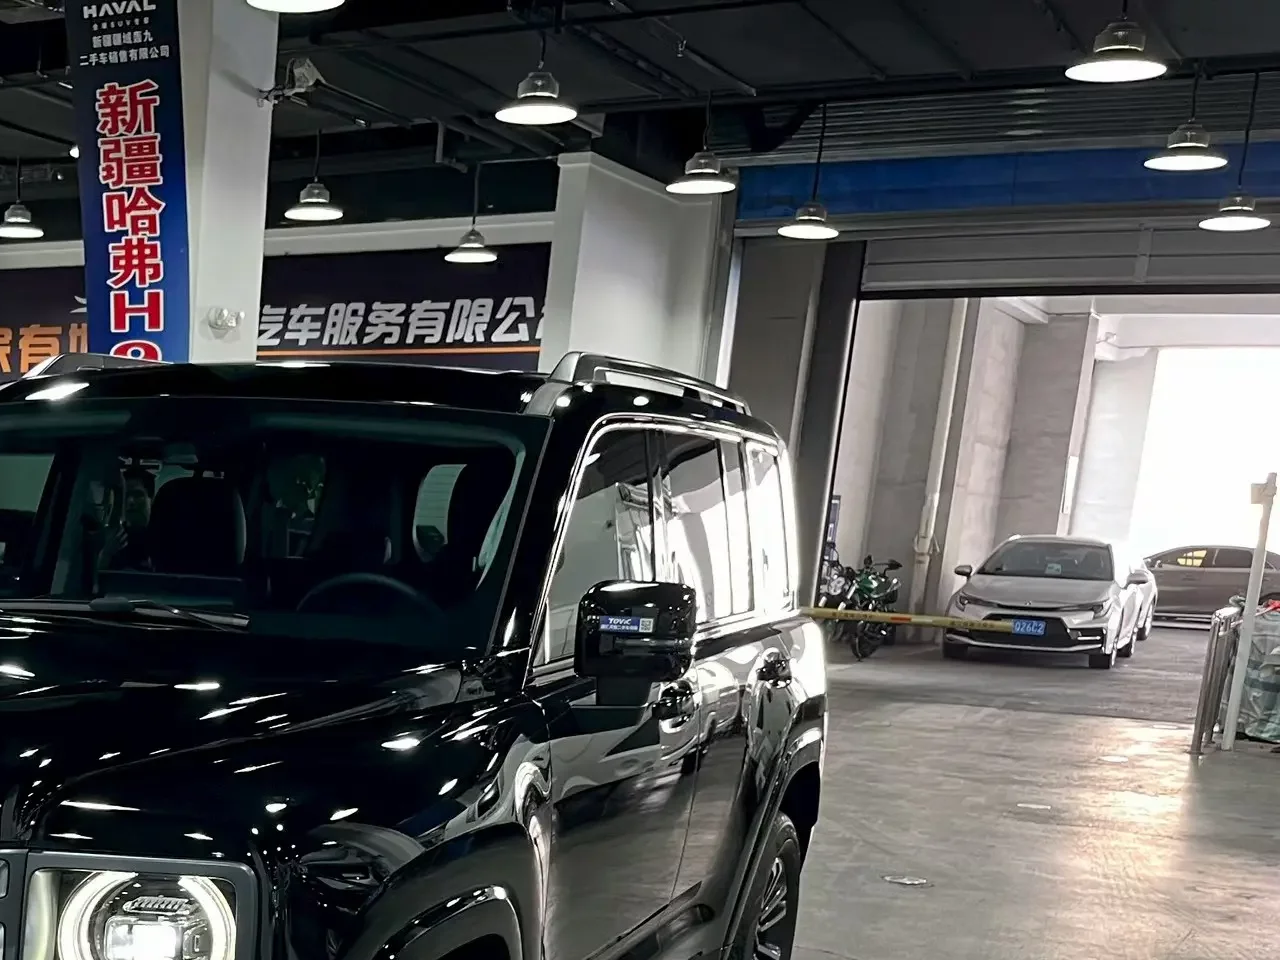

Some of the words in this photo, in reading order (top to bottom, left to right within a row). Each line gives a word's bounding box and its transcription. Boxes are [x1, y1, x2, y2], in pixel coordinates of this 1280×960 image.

[83, 0, 157, 19] HAVAL
[79, 45, 170, 66] 二手车销售有限公司
[257, 297, 545, 347] 汽车服务有限公
